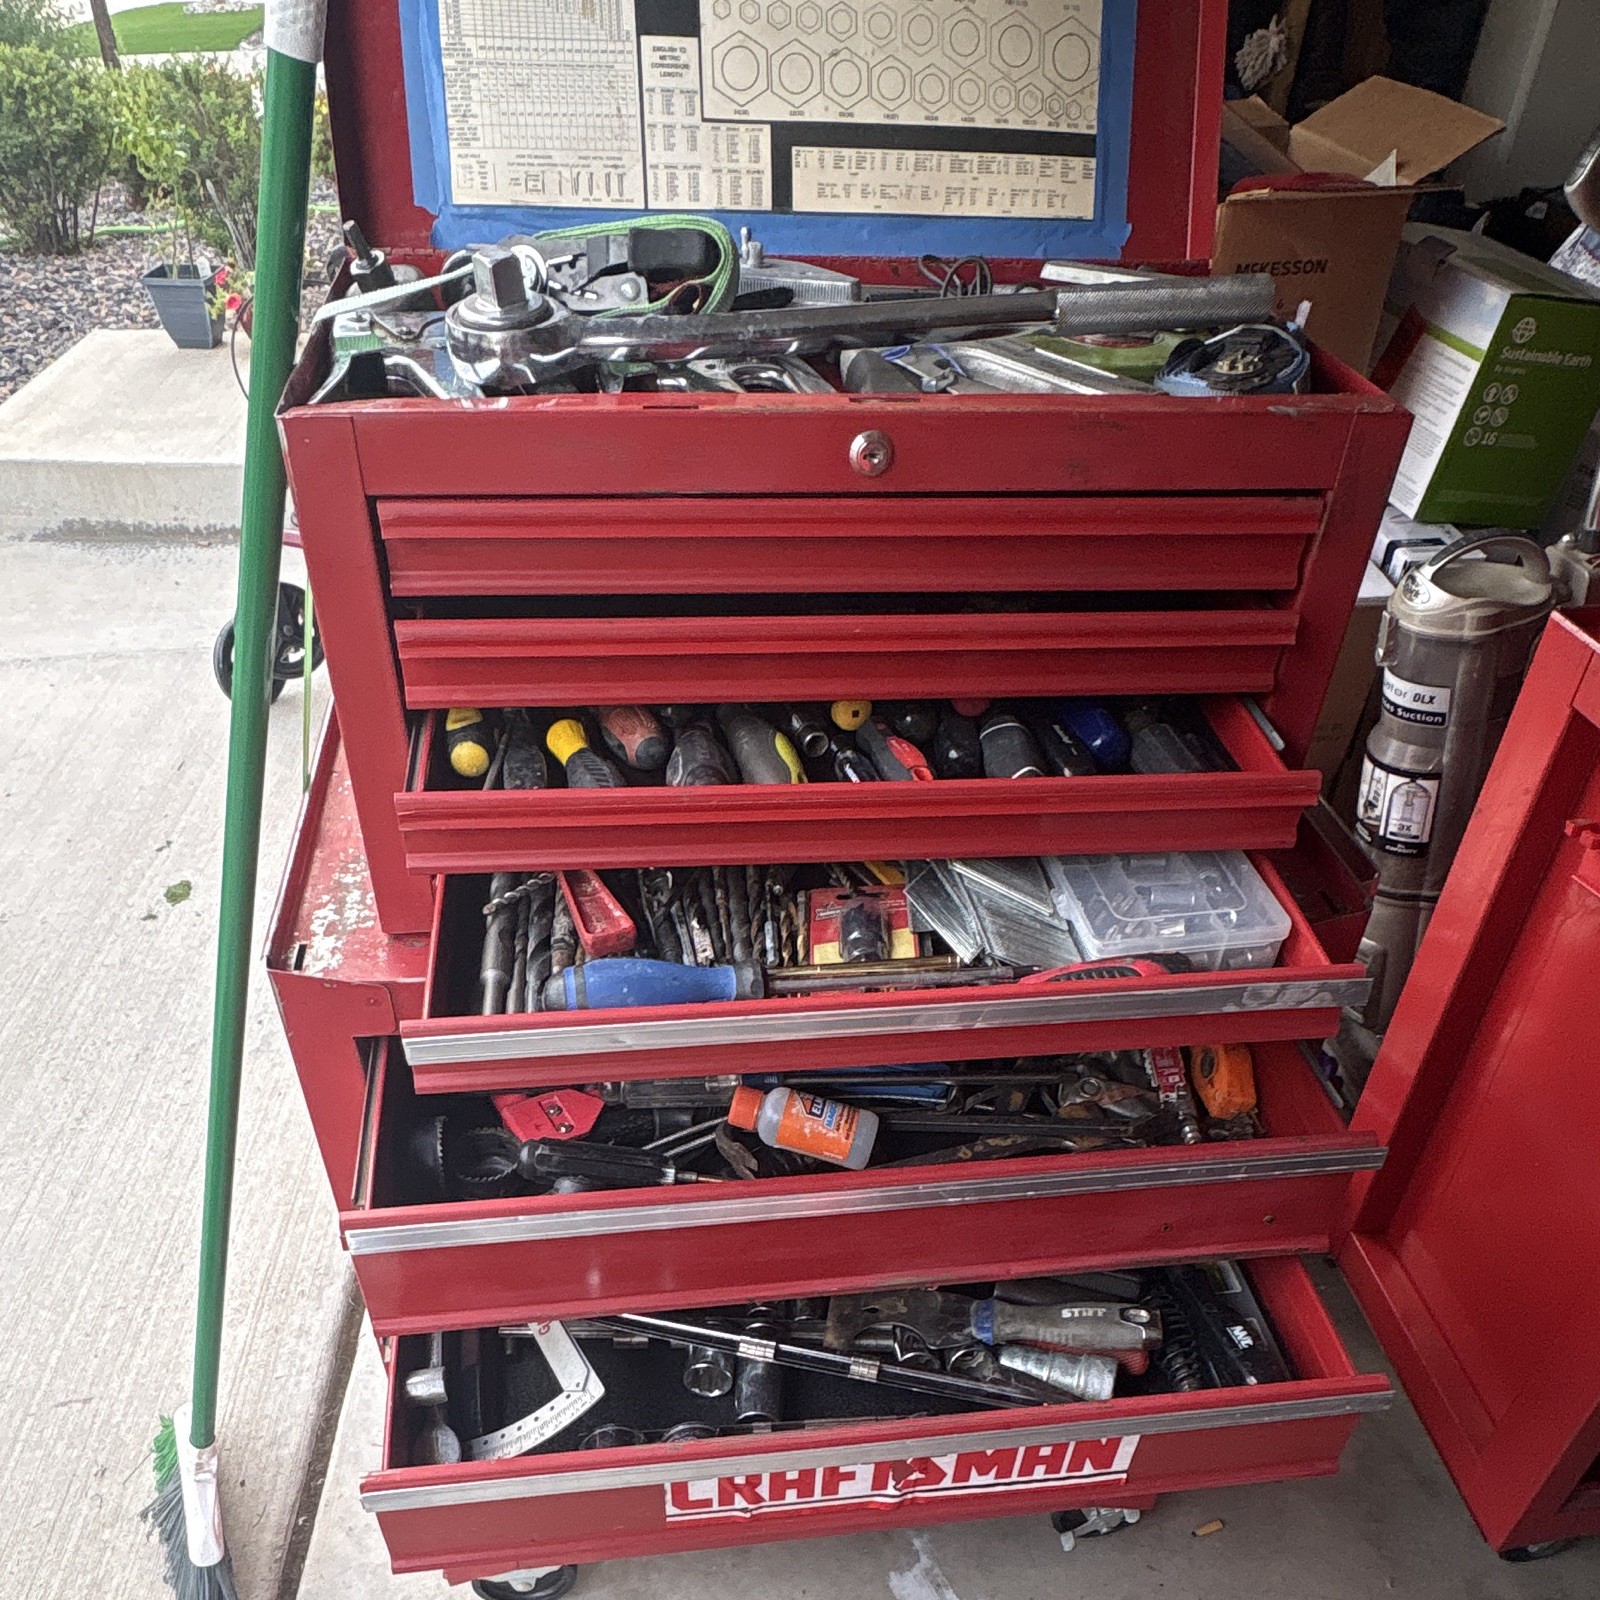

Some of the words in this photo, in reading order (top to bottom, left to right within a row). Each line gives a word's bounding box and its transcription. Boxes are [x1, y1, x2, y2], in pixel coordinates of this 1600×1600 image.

[1501, 346, 1563, 364] Sustainable
[1563, 353, 1592, 367] Earth
[1413, 692, 1436, 705] DLX
[1397, 708, 1443, 723] Suction
[1061, 1307, 1107, 1319] STIFF
